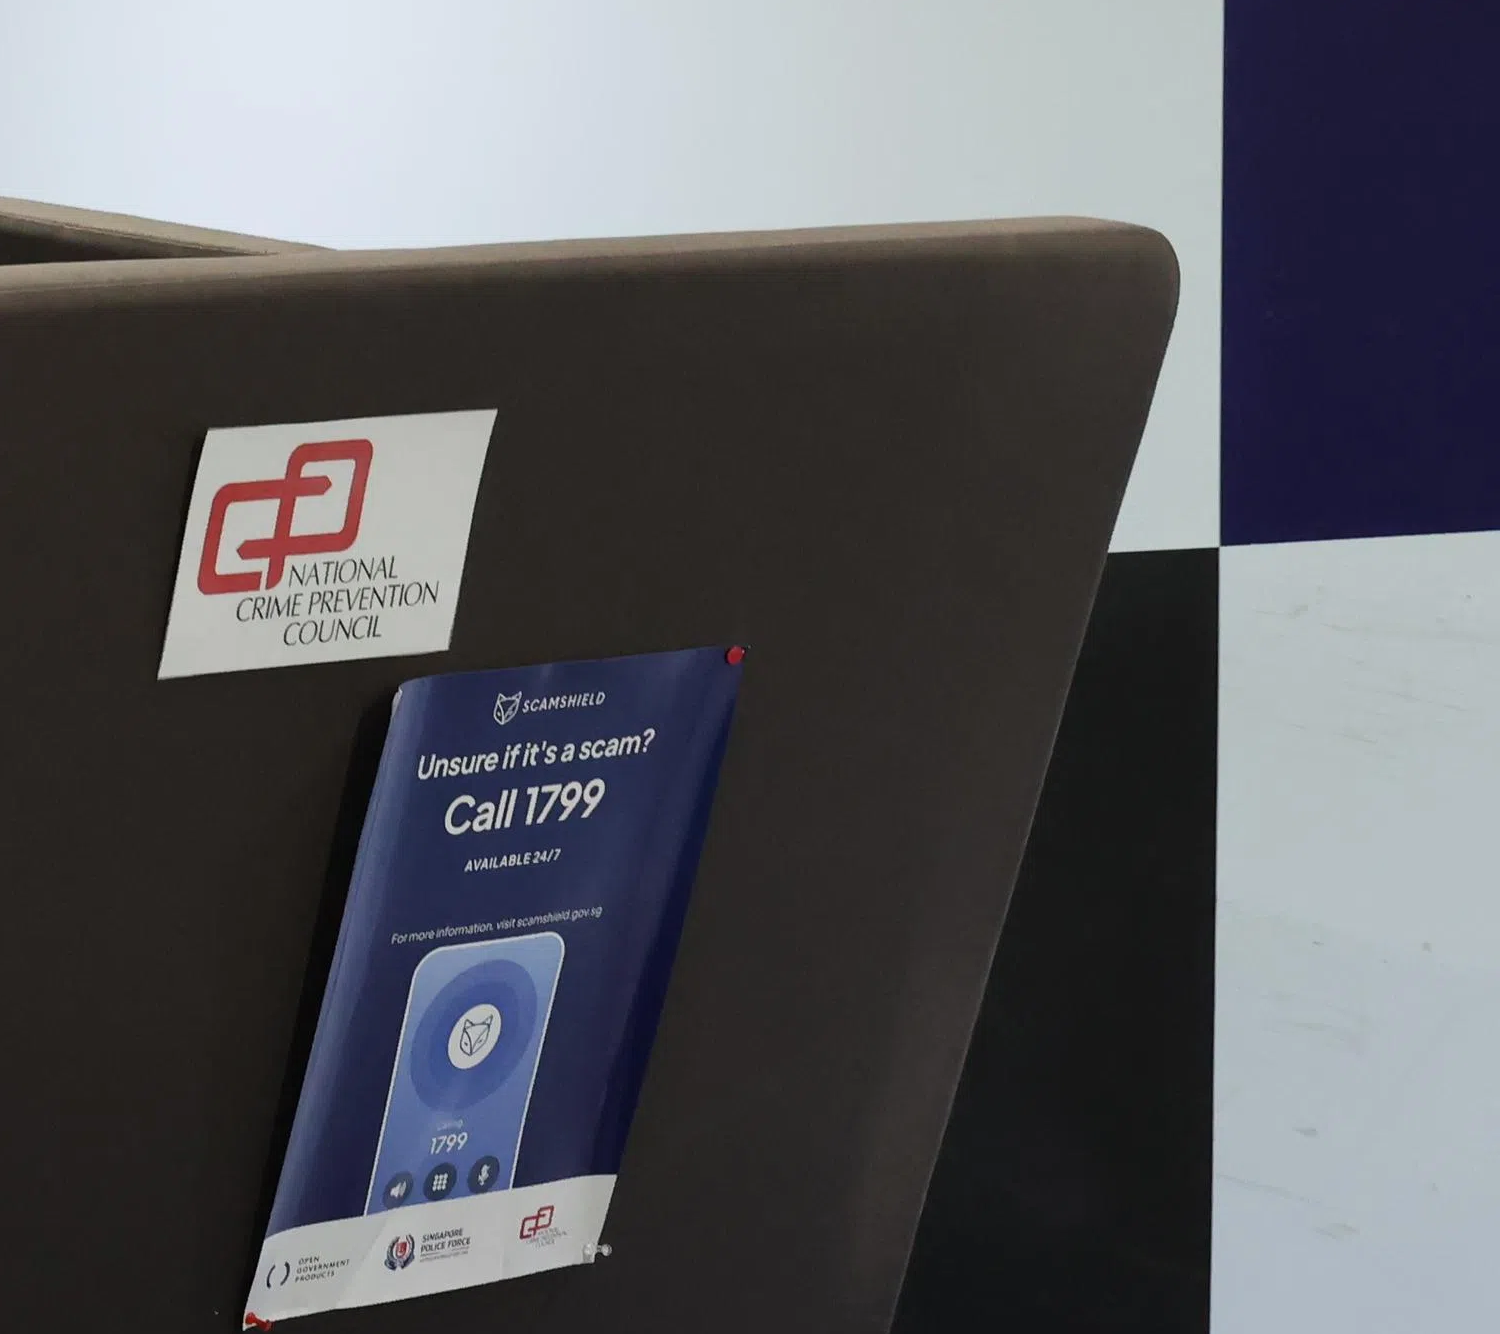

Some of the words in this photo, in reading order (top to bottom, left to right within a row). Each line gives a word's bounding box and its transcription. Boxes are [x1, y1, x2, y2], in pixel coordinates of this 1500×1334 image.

[289, 556, 399, 588] NATIONAL
[236, 593, 304, 622] CRIME
[307, 581, 440, 616] PREVENTION
[283, 616, 382, 646] COUNCIL
[522, 692, 606, 714] SCAMSHIELD
[417, 752, 499, 780] Unsure
[502, 742, 521, 770] if
[522, 741, 558, 768] it's
[560, 742, 576, 762] a
[579, 728, 656, 760] scam?
[444, 788, 518, 835] Call
[525, 778, 606, 826] 1799
[464, 852, 531, 872] AVAILABLE
[532, 848, 562, 864] 24/7
[391, 933, 408, 945] For
[408, 930, 435, 942] more
[496, 918, 516, 930] visit
[431, 1132, 468, 1154] 1799
[420, 1242, 446, 1253] POLICE
[447, 1237, 471, 1250] FORCE
[422, 1228, 464, 1243] SINGAPORE
[296, 1259, 350, 1275] GOVERNMENT
[298, 1256, 320, 1266] OPEN
[295, 1271, 335, 1283] PRODUCTS
